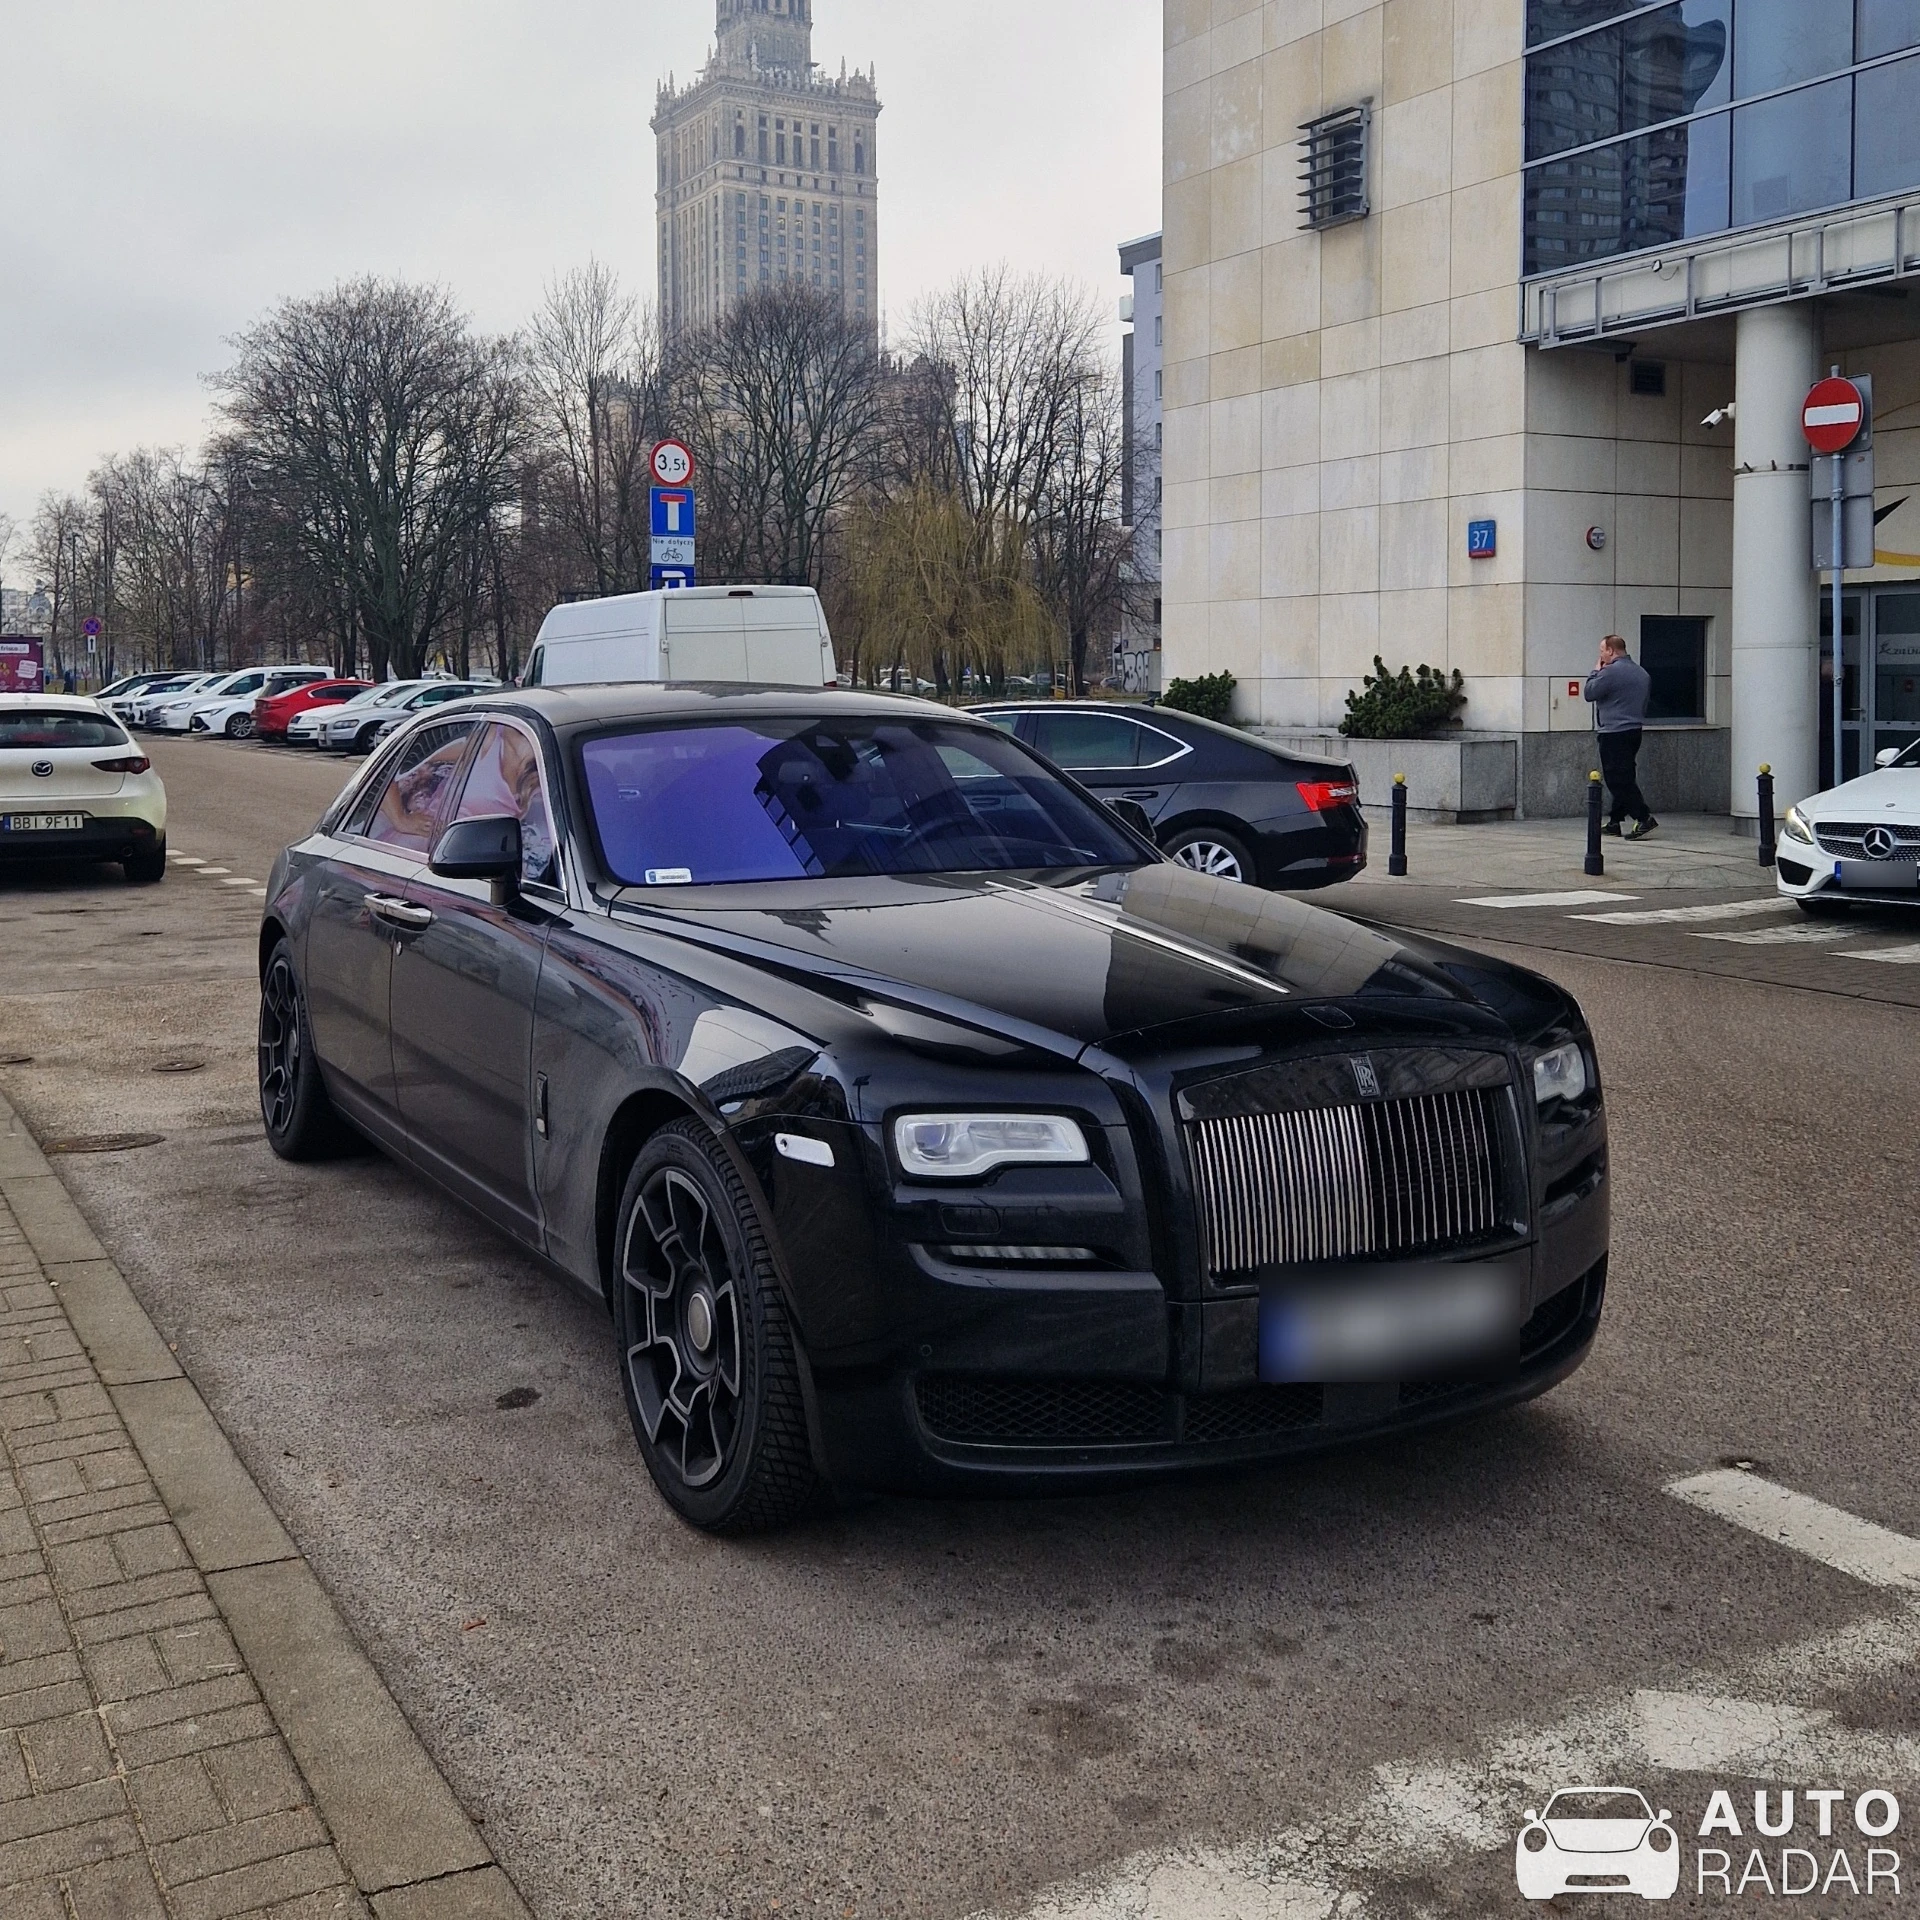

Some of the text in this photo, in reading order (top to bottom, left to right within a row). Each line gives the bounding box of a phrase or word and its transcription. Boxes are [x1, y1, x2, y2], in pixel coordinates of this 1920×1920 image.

[657, 453, 687, 473] 3,5t
[652, 537, 665, 545] Nie
[1473, 530, 1489, 549] 37
[13, 816, 79, 830] BBI 9F11
